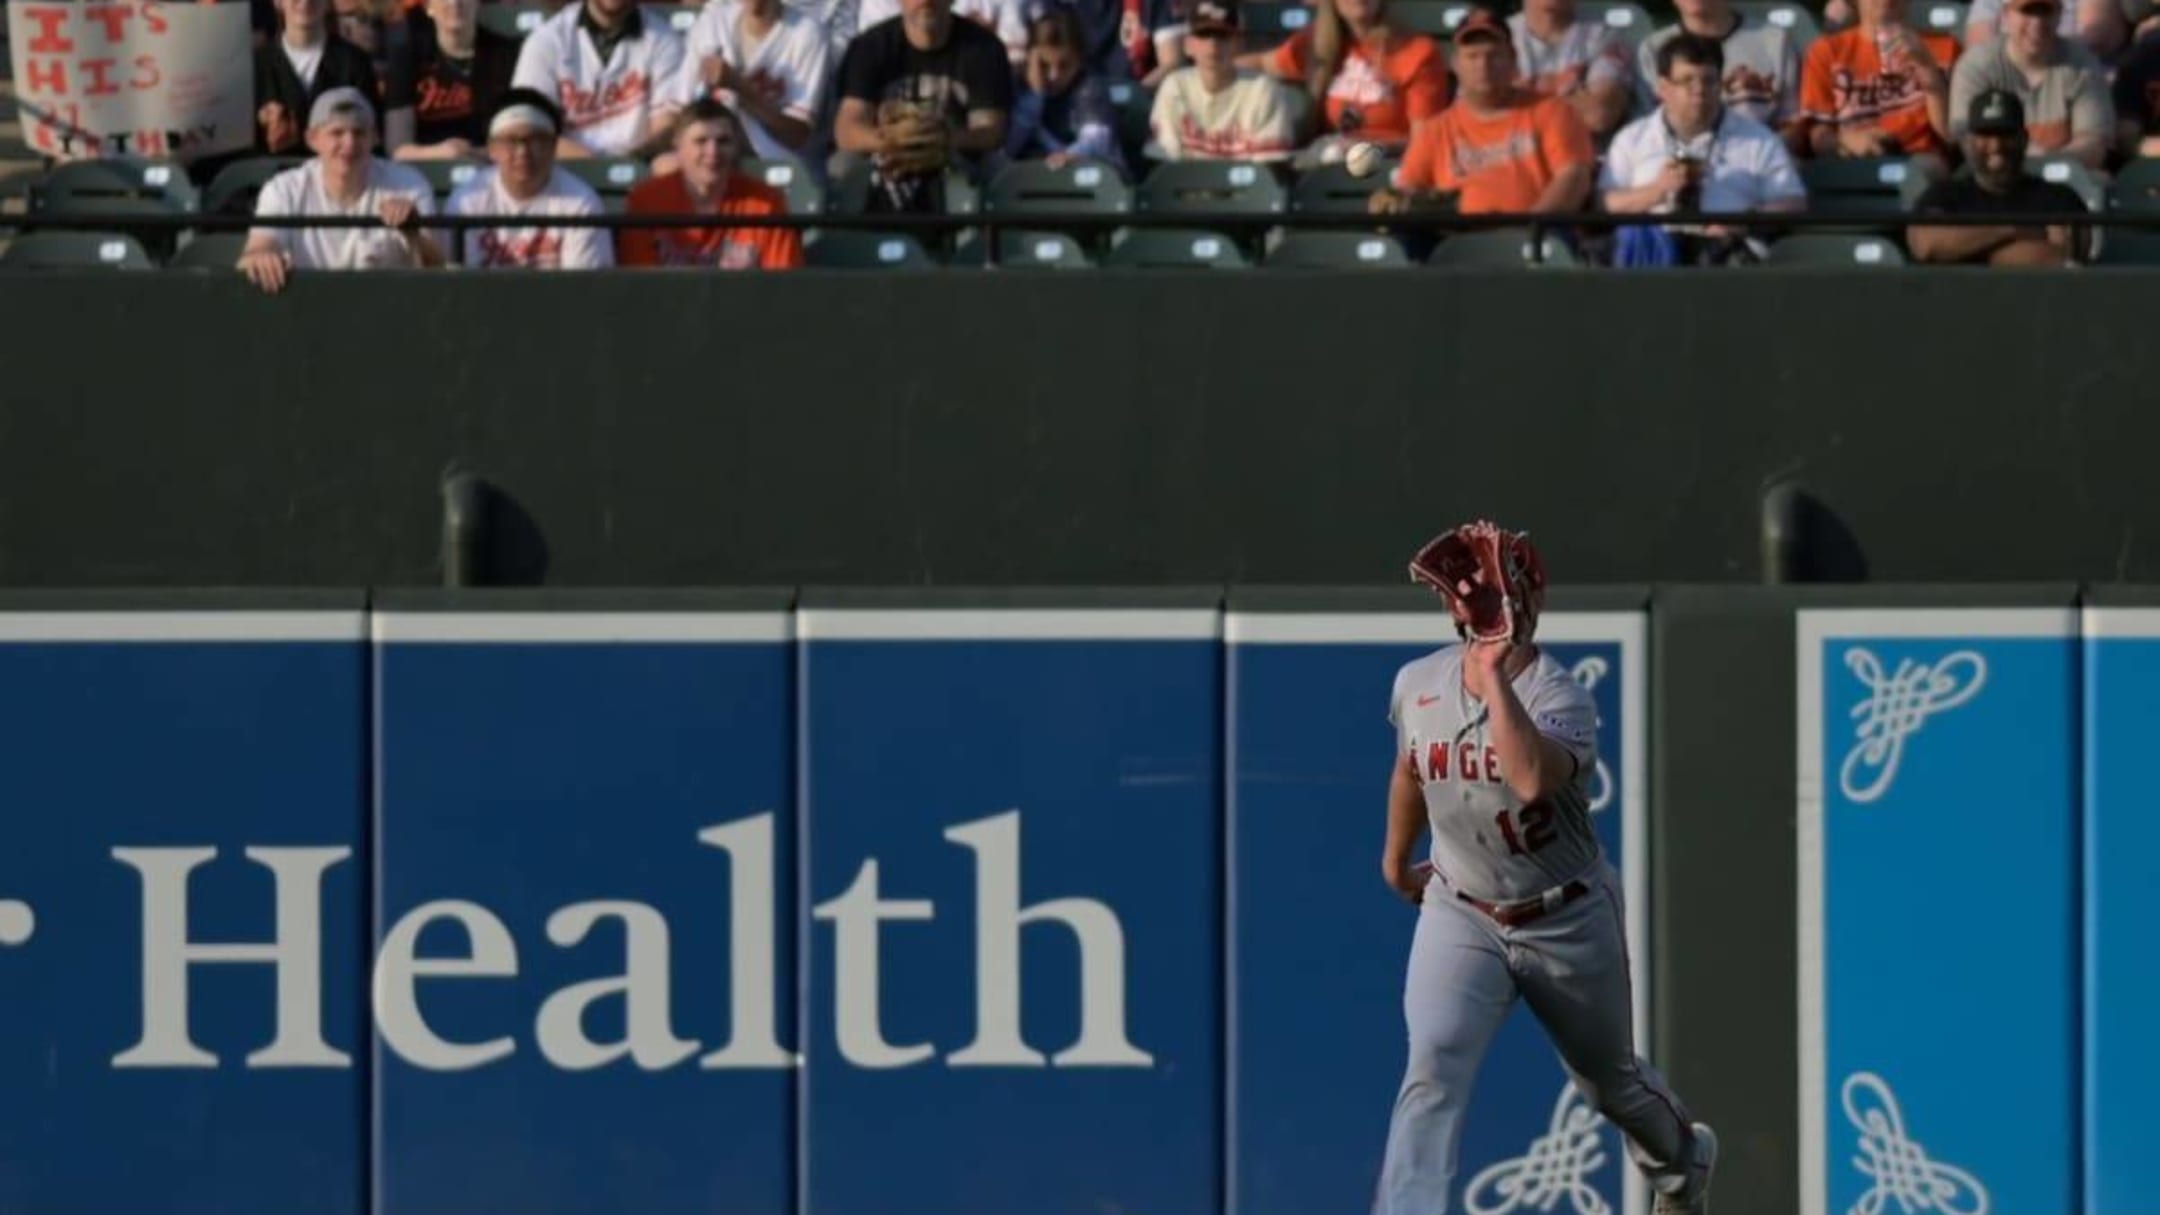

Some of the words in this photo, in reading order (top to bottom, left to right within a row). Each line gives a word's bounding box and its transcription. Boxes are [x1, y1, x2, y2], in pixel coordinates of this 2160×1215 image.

[27, 53, 161, 96] HIS
[1407, 740, 1504, 786] ANGE
[1495, 797, 1560, 857] 12
[110, 808, 1154, 1070] Health
